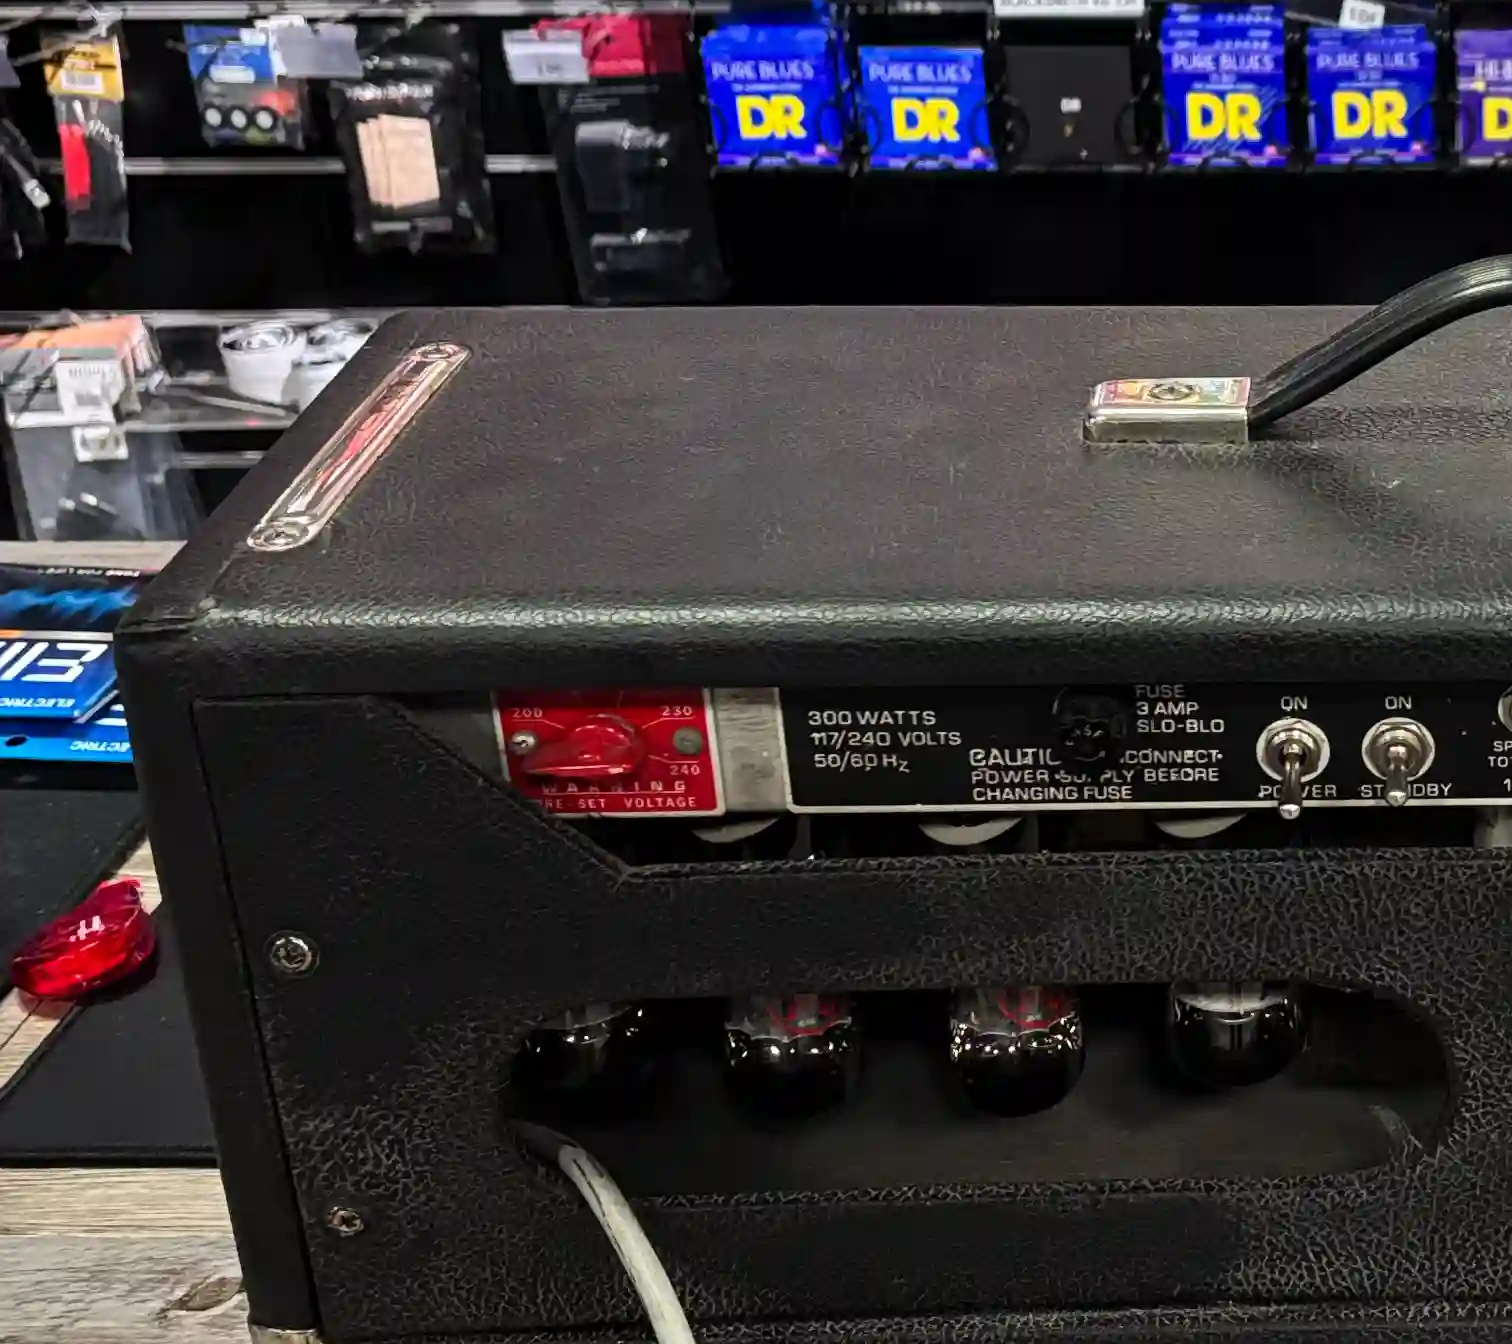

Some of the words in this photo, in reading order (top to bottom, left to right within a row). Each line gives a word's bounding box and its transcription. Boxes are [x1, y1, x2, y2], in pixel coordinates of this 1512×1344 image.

[736, 94, 806, 140] DR
[891, 96, 960, 142] DR
[1186, 92, 1262, 141] DR
[1331, 89, 1408, 140] DR
[1134, 684, 1186, 698] FUSE
[1136, 701, 1149, 716] 3
[1154, 701, 1200, 716] AMP
[1281, 696, 1308, 710] ON
[1385, 696, 1412, 709] ON
[513, 708, 543, 718] 200
[660, 706, 692, 716] 230
[808, 711, 852, 725] 300
[856, 710, 936, 725] WATTS
[1136, 719, 1225, 733] SLO-BLO
[811, 730, 891, 750] 117/240
[898, 732, 961, 746] VOLTS
[814, 751, 878, 771] 50/60
[670, 765, 700, 775] 240
[971, 770, 1050, 784] POWER
[1144, 768, 1219, 782] BEFORE
[972, 786, 1078, 801] CHANGING
[1084, 785, 1133, 799] FUSE
[624, 797, 697, 807] VOLTAGE
